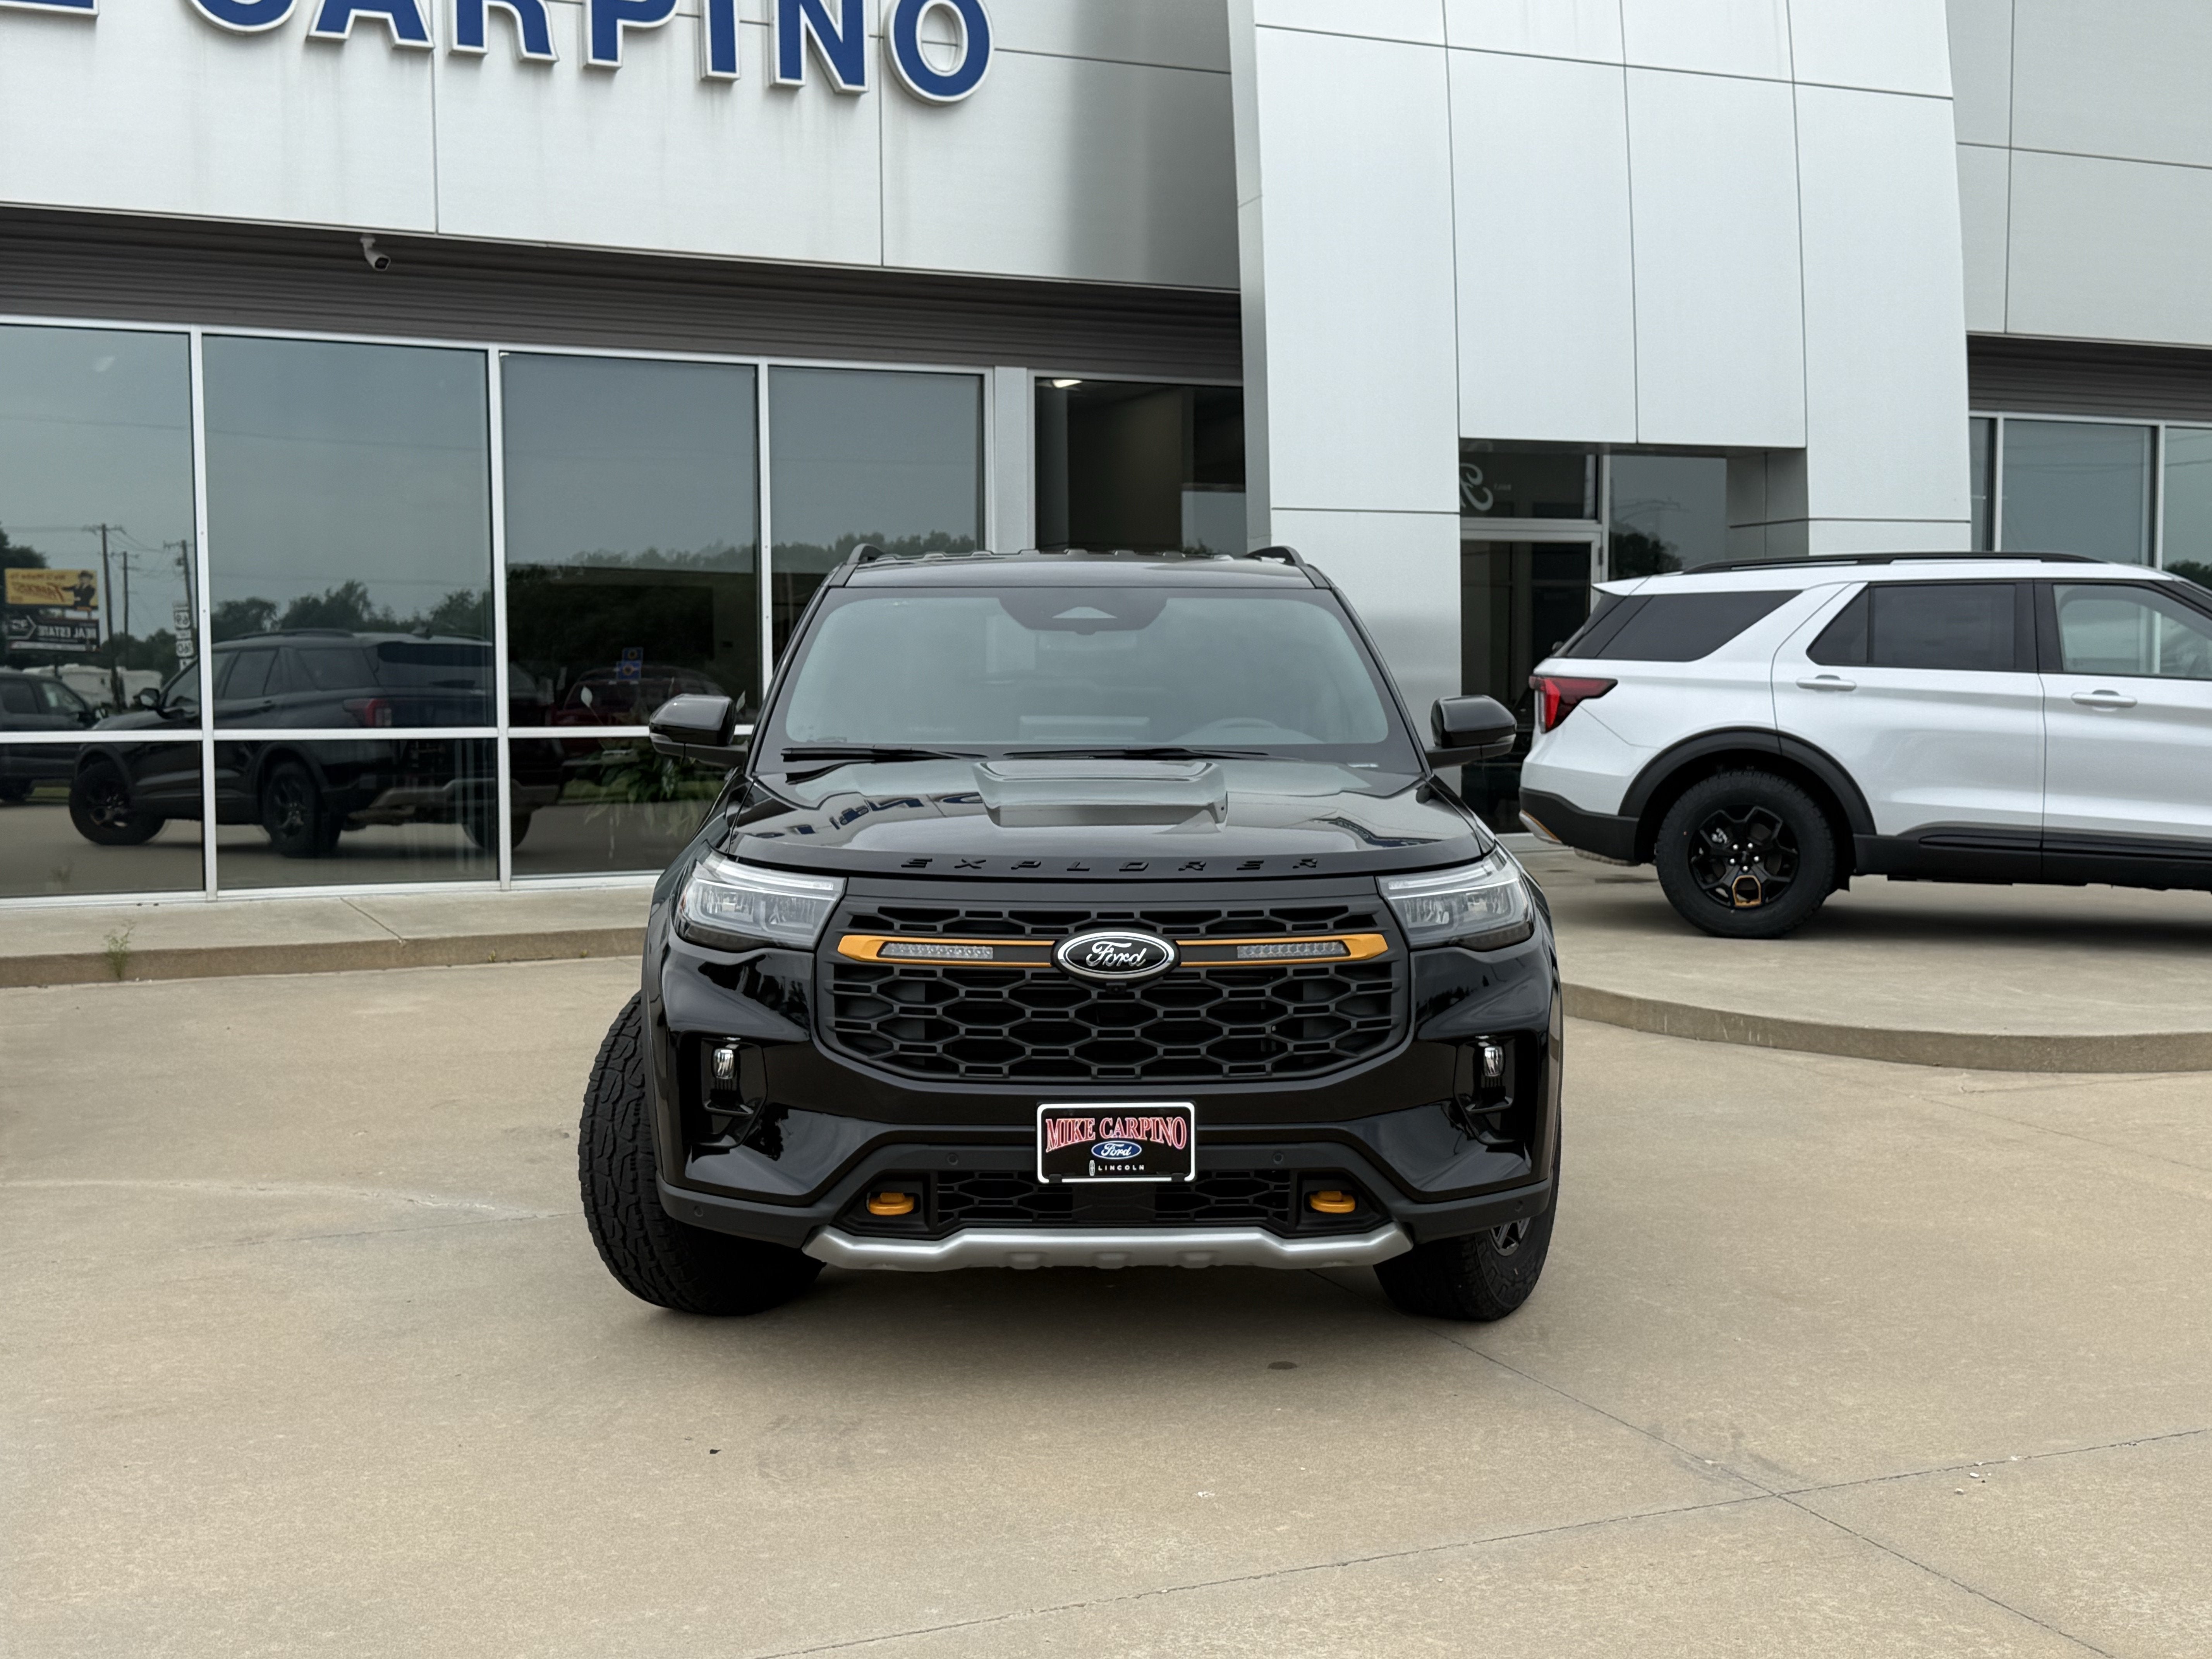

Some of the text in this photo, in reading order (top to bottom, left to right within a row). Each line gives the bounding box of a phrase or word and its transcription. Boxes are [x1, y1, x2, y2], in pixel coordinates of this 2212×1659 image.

[185, 0, 994, 104] PINO
[901, 857, 1317, 872] EXPLORER
[1085, 941, 1147, 967] Ford
[1046, 1116, 1187, 1153] MIKE CARPINO
[1101, 1143, 1132, 1156] Ford
